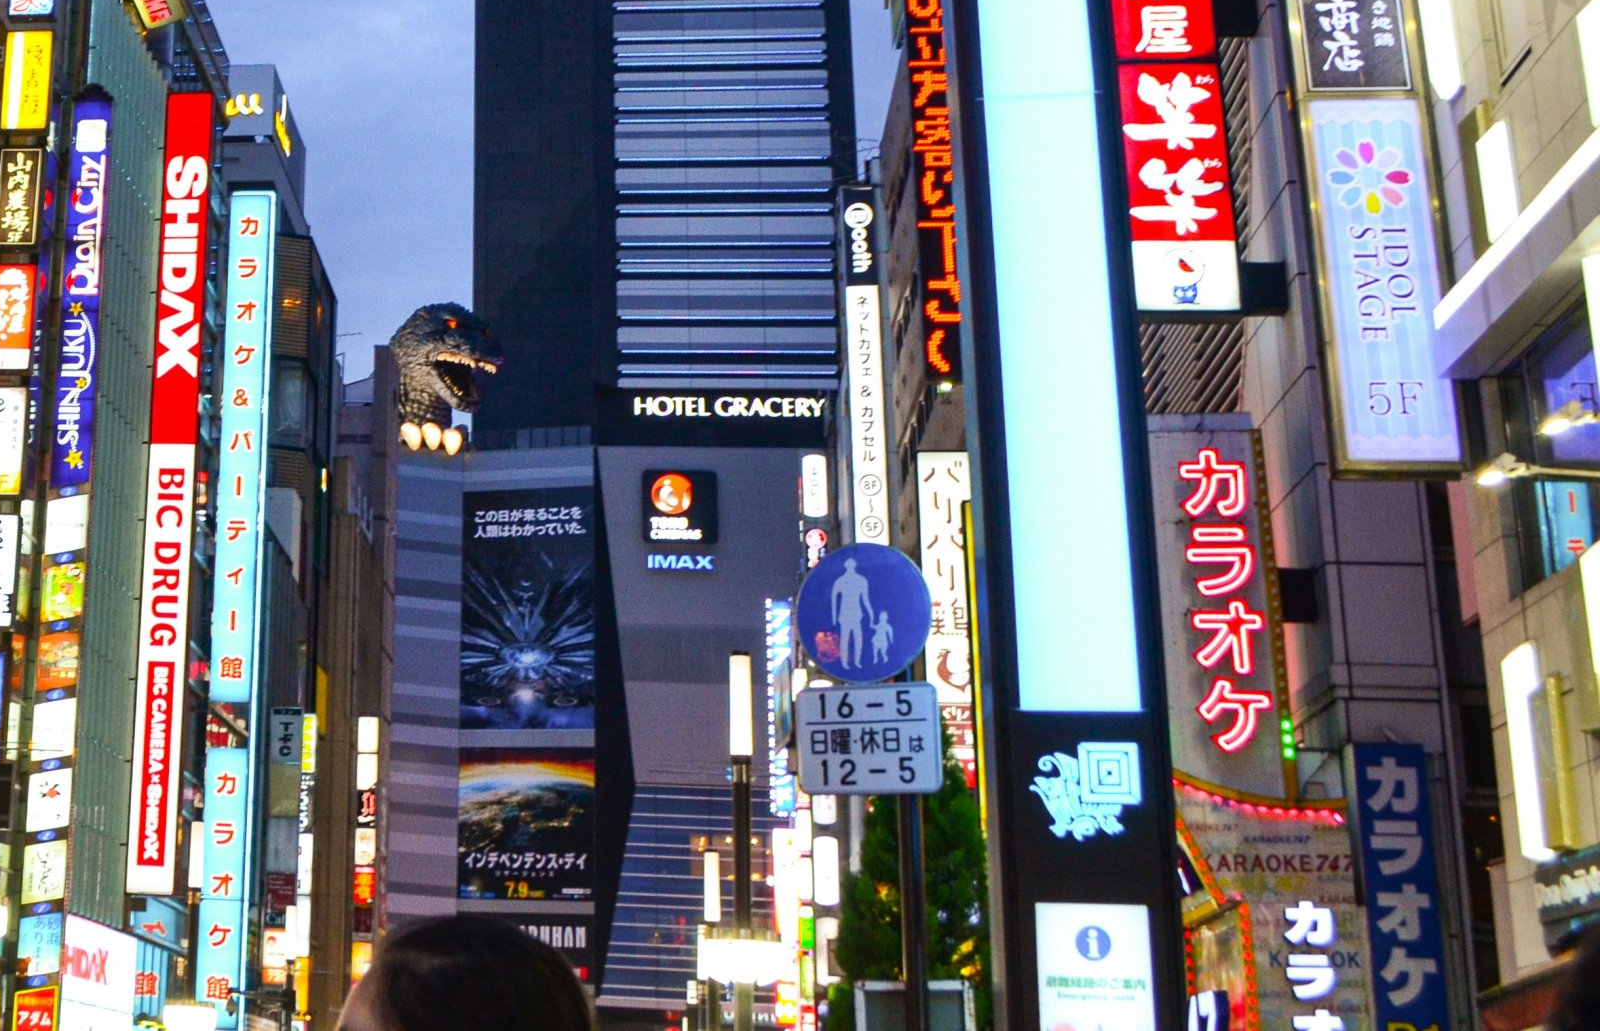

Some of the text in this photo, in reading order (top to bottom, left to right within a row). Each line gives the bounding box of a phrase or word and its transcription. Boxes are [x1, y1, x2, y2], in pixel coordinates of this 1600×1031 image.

[155, 155, 208, 379] SHIDAX
[844, 201, 874, 274] Booth
[1349, 227, 1389, 344] STAGE
[1382, 225, 1418, 322] IDOL
[56, 319, 87, 446] SHINJUKU
[633, 396, 826, 418] HOTEL GRACERY
[1367, 379, 1425, 417] 5F
[219, 217, 261, 680] カラオケ&パーティー館
[150, 468, 185, 647] BIC DRUG
[474, 507, 582, 523] この日が来ることを
[474, 522, 587, 538] 人類はわかっていた。
[647, 555, 714, 570] IMAX
[1179, 447, 1272, 754] カラオケ
[142, 665, 169, 861] BIC CAMERA SHIDAX
[206, 772, 238, 1000] カラオケ館
[465, 852, 588, 870] インデペンデンス・デイ
[1367, 757, 1437, 1009] カラオケ
[62, 944, 109, 986] HIDAX
